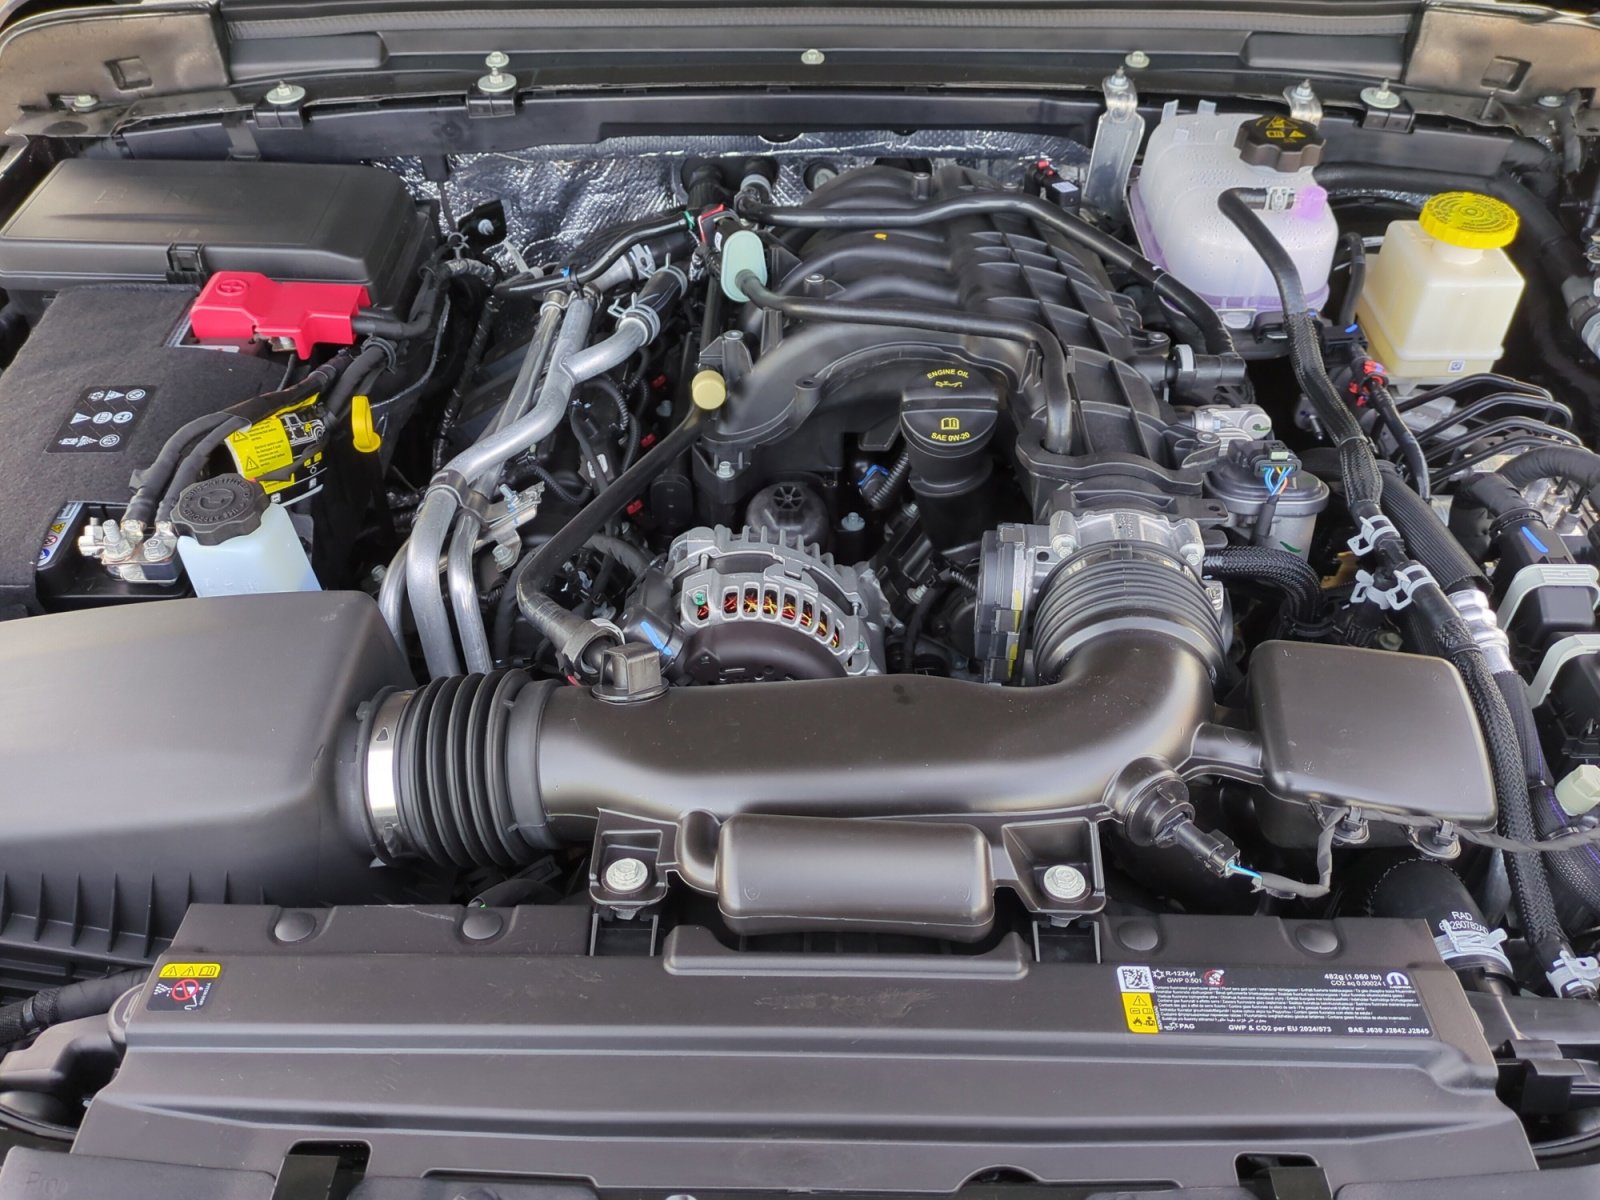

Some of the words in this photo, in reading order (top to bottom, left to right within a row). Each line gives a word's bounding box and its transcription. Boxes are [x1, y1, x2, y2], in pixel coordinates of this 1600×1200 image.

[927, 369, 956, 379] ENGINE
[957, 370, 969, 378] OIL
[931, 432, 947, 441] SAE
[948, 431, 970, 441] 0W-20
[1451, 911, 1472, 920] RAD
